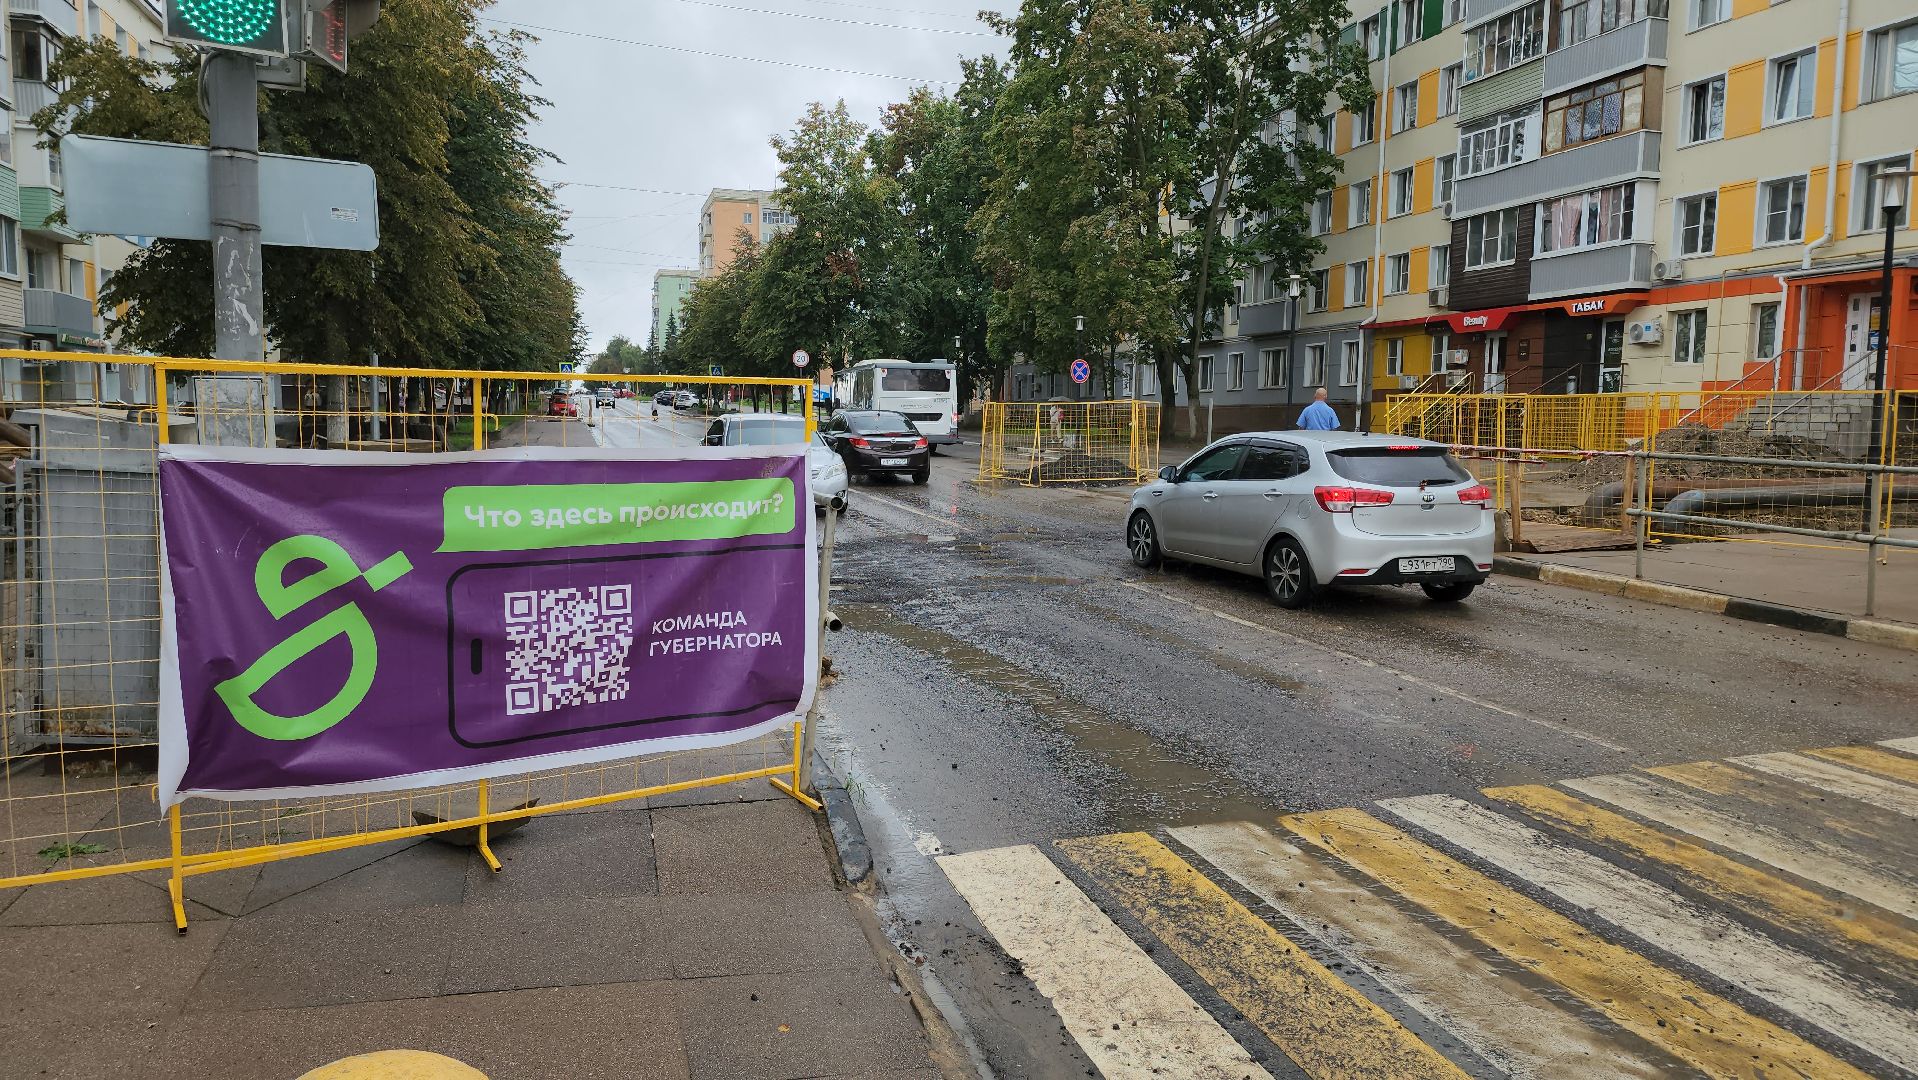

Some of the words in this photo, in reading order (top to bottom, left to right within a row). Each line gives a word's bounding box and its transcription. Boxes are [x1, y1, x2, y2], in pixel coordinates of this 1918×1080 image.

[1571, 299, 1605, 313] ТАБАК
[796, 355, 806, 363] 20
[464, 505, 523, 528] Что
[530, 505, 614, 529] здесь
[618, 493, 785, 528] происходит?
[651, 611, 748, 635] КОМАНДА
[649, 632, 783, 657] ГУБЕРНАТОРА
